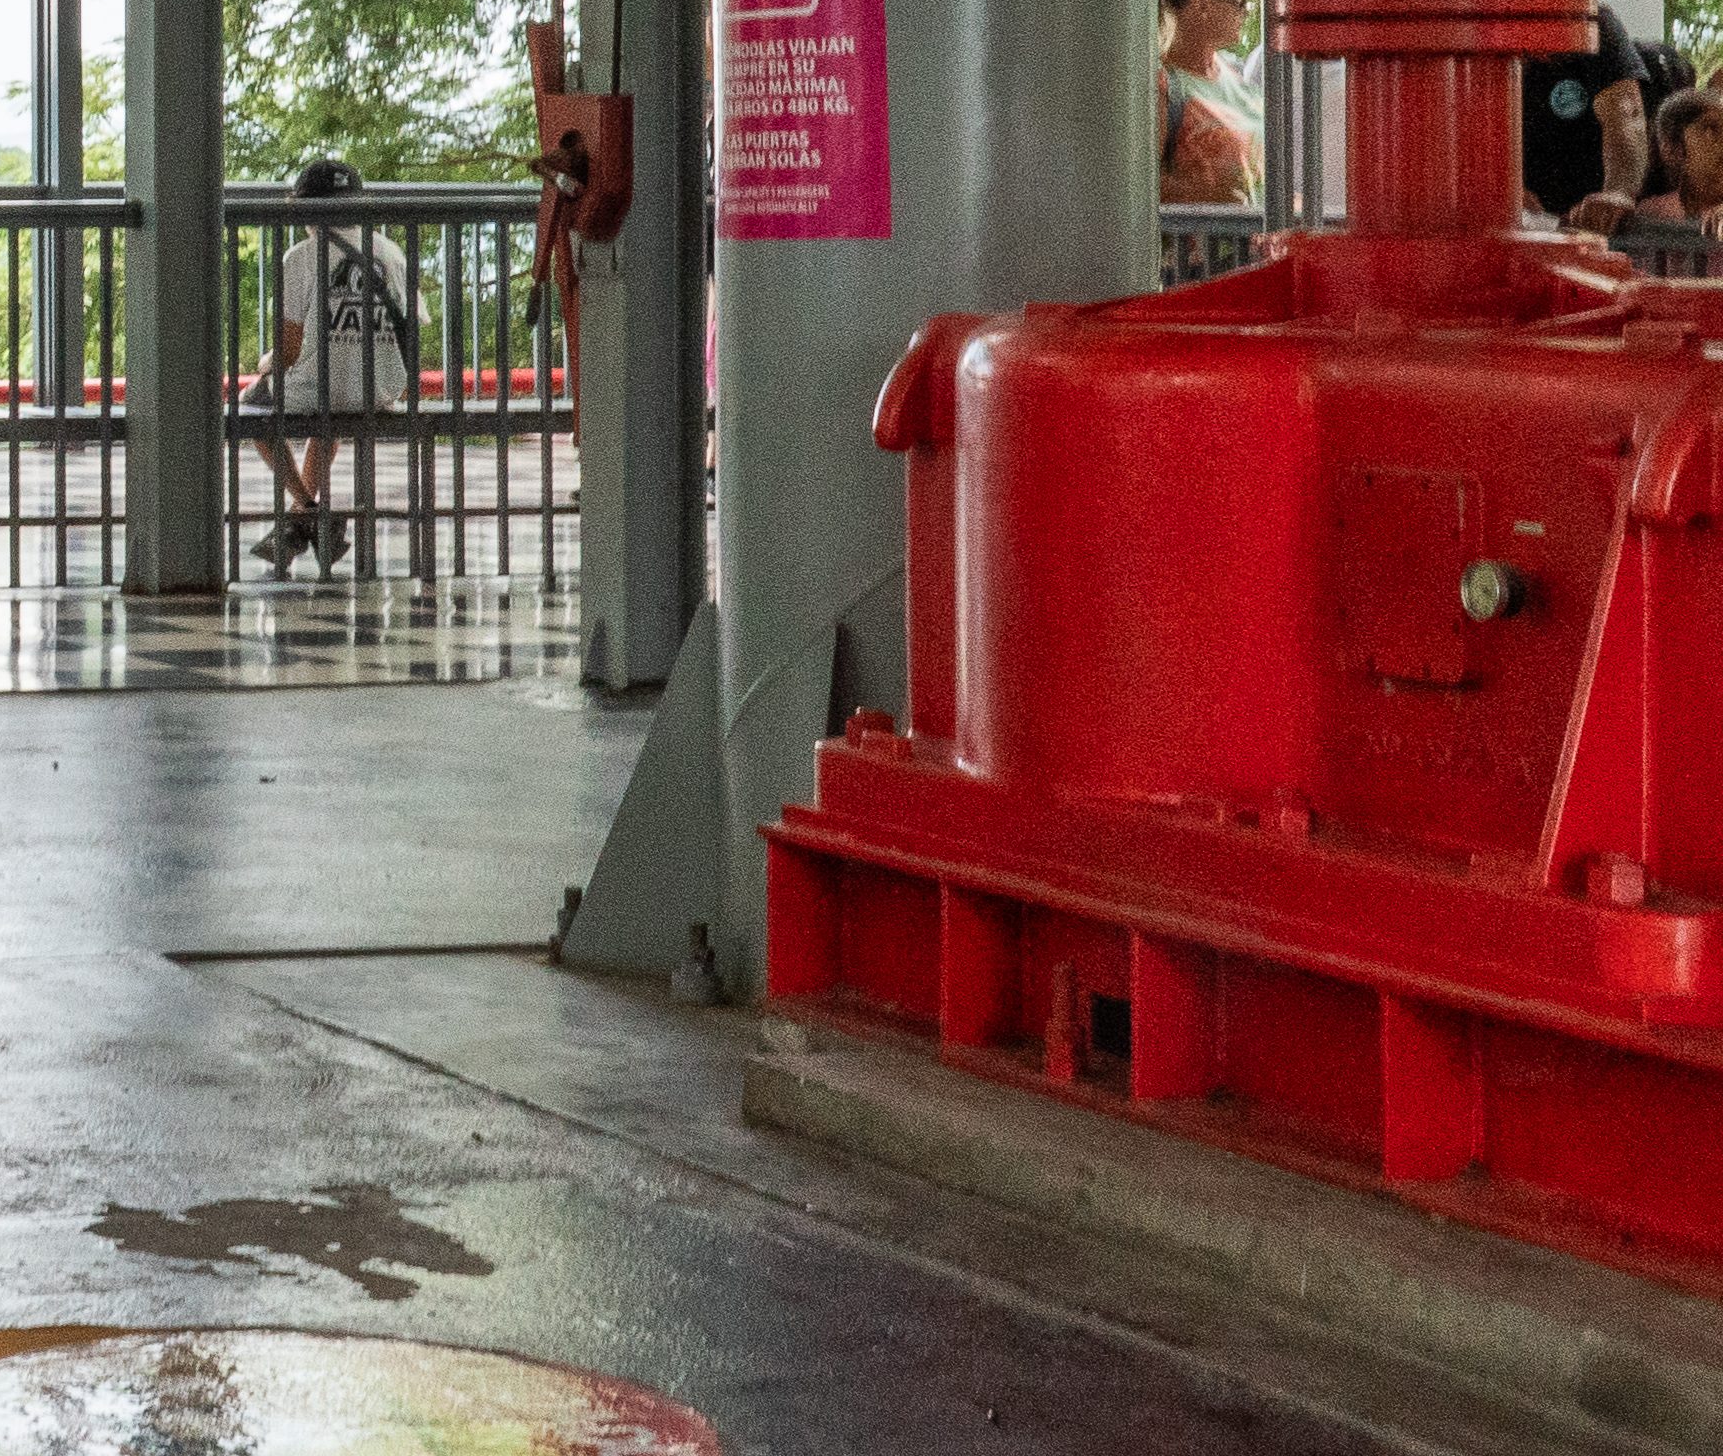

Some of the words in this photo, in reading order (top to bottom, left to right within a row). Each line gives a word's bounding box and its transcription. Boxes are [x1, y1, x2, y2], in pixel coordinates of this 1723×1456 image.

[789, 35, 855, 57] VIAJAN
[768, 59, 789, 76] EN
[793, 57, 816, 76] SU
[772, 98, 784, 115] O
[745, 130, 809, 148] PUERTAS
[768, 148, 822, 169] SOLAS
